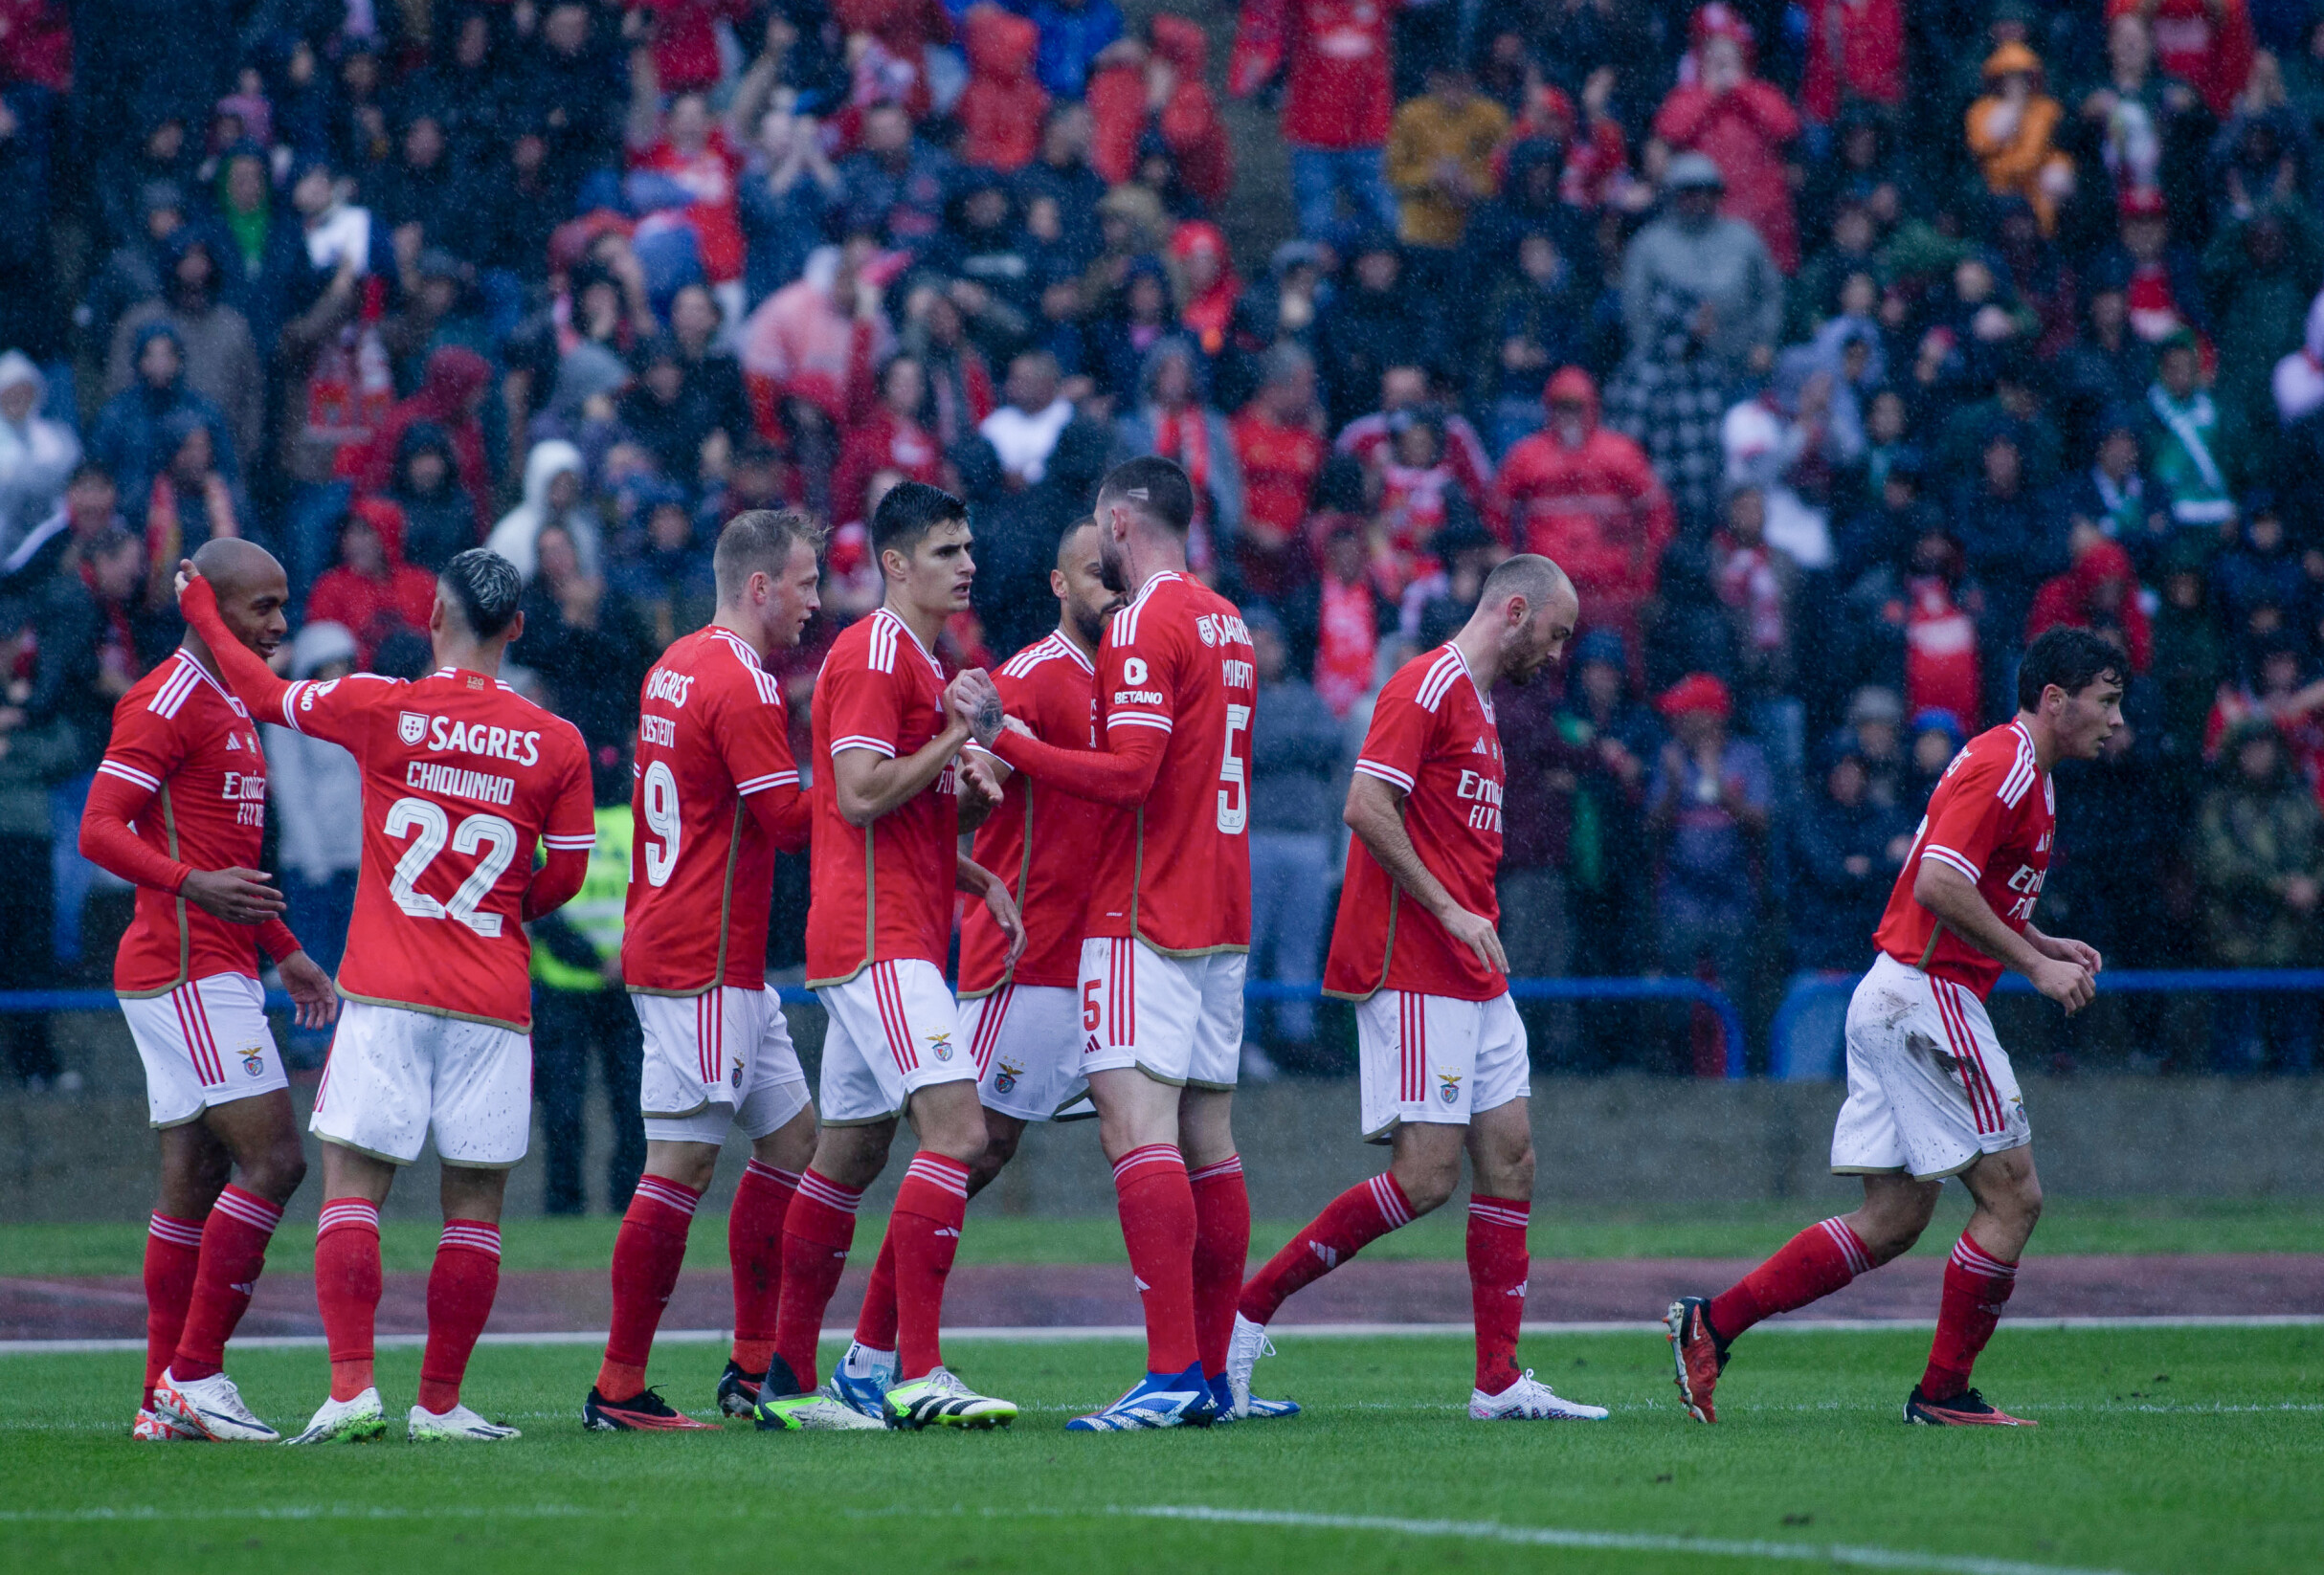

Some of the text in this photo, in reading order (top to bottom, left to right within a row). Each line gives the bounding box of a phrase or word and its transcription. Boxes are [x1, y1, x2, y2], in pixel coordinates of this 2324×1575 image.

[1114, 690, 1163, 705] BETANO
[427, 716, 541, 767] SAGRES
[1217, 703, 1251, 834] 5
[406, 760, 515, 806] CHIQUINHO
[629, 760, 682, 888] 9
[383, 796, 518, 938] 22
[1083, 978, 1102, 1032] 5
